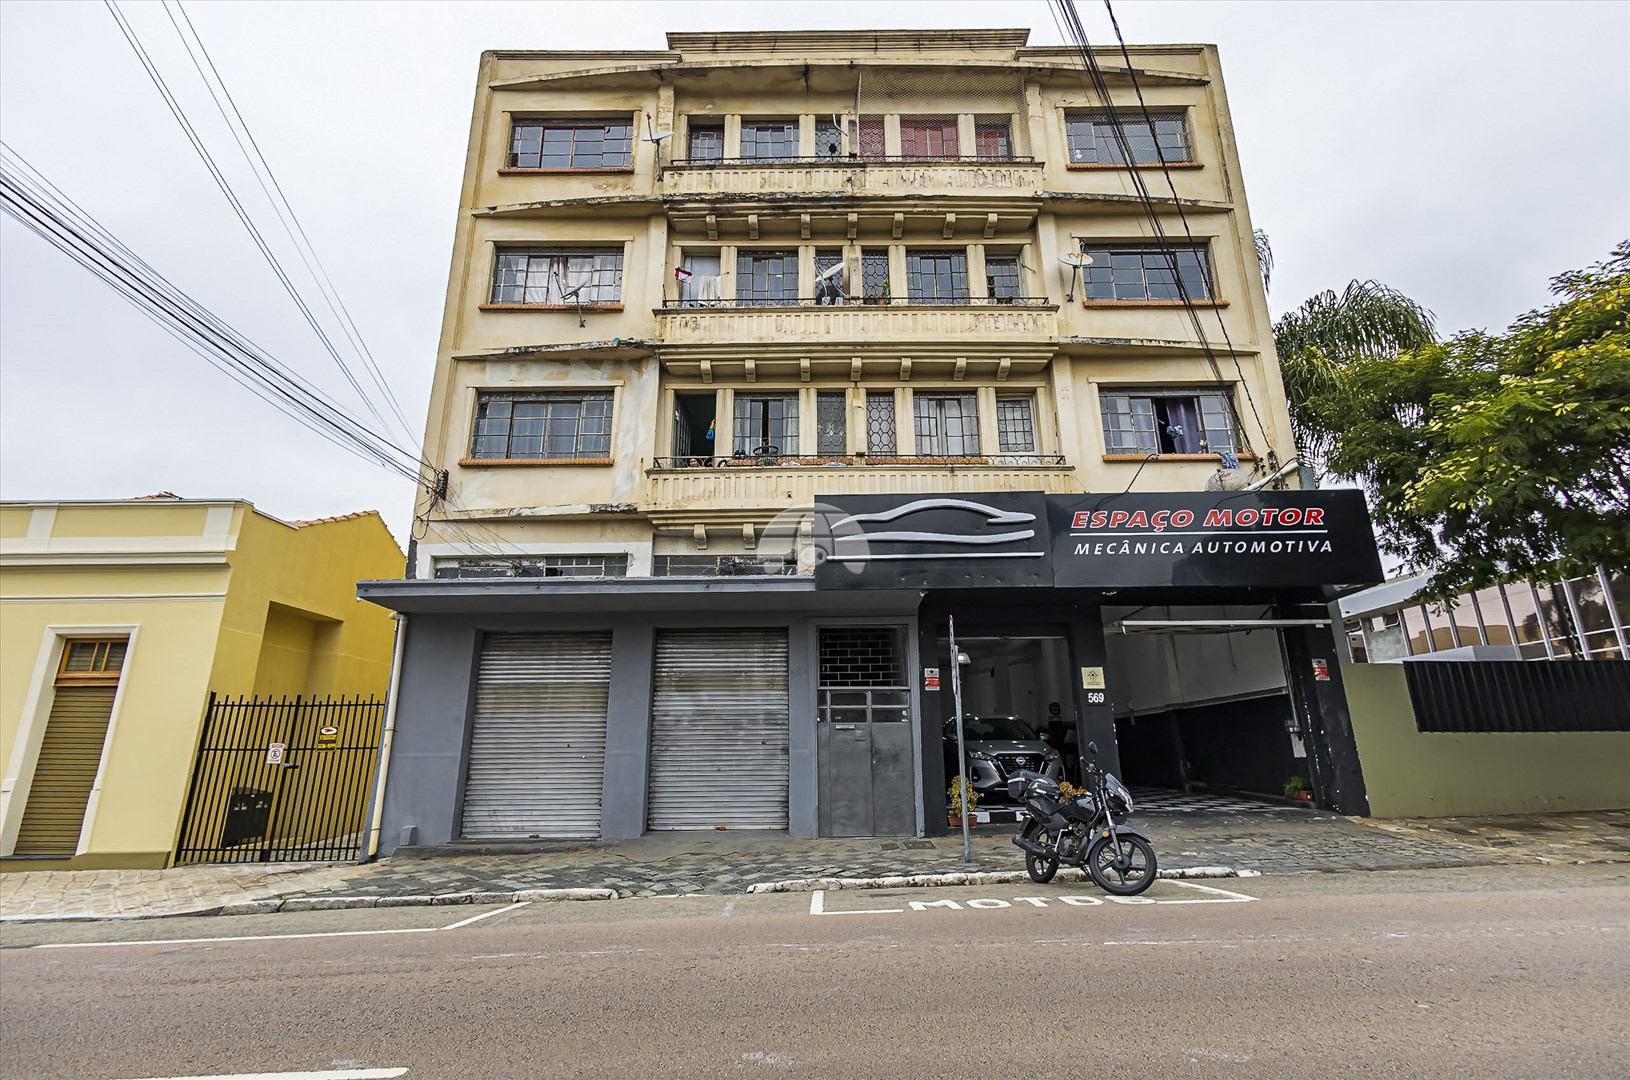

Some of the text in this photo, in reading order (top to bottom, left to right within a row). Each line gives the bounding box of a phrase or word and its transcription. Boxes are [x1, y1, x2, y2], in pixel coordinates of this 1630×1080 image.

[1071, 508, 1324, 533] ESPAÇO MOTOR
[1074, 540, 1332, 555] MECÂNICA AUTOMOTIVA
[1088, 692, 1104, 703] 569
